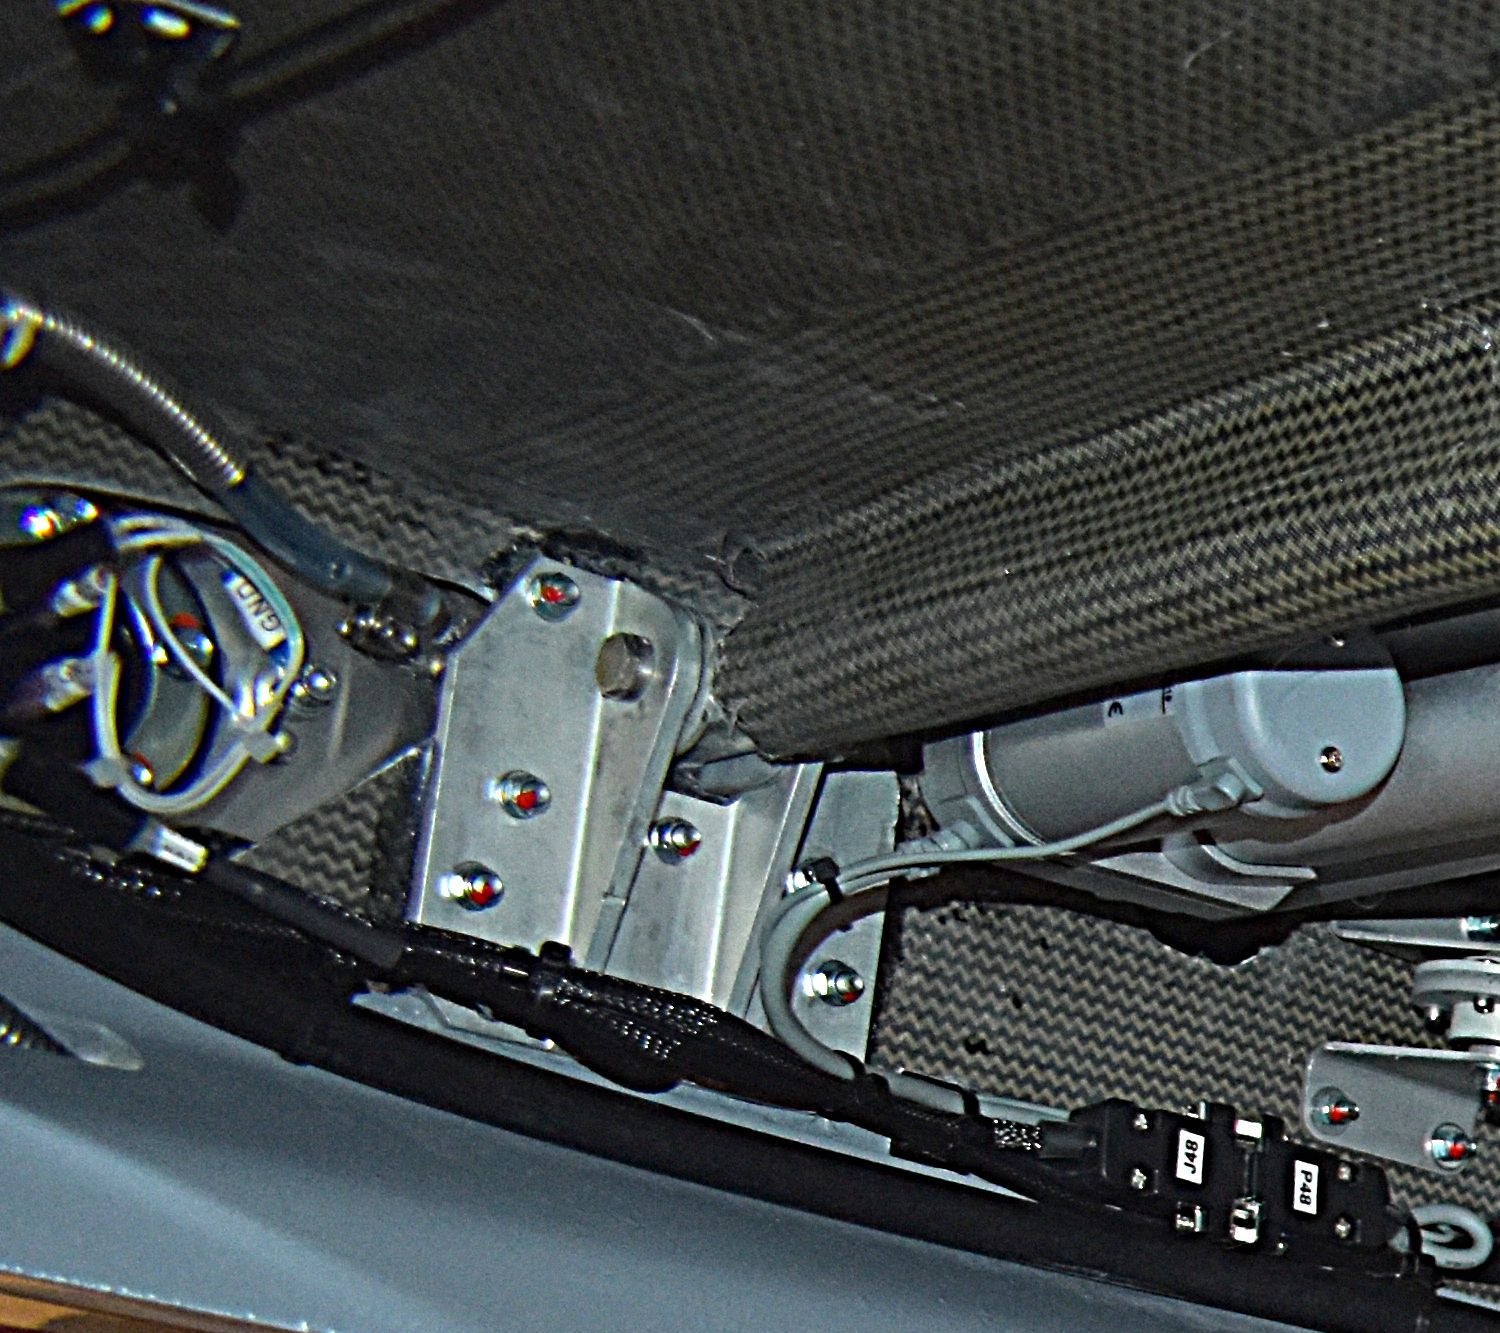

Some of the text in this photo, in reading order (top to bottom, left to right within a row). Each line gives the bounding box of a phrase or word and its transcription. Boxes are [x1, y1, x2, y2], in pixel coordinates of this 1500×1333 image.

[237, 583, 281, 631] GND
[1184, 1139, 1198, 1174] J48
[1300, 1169, 1313, 1205] P48
